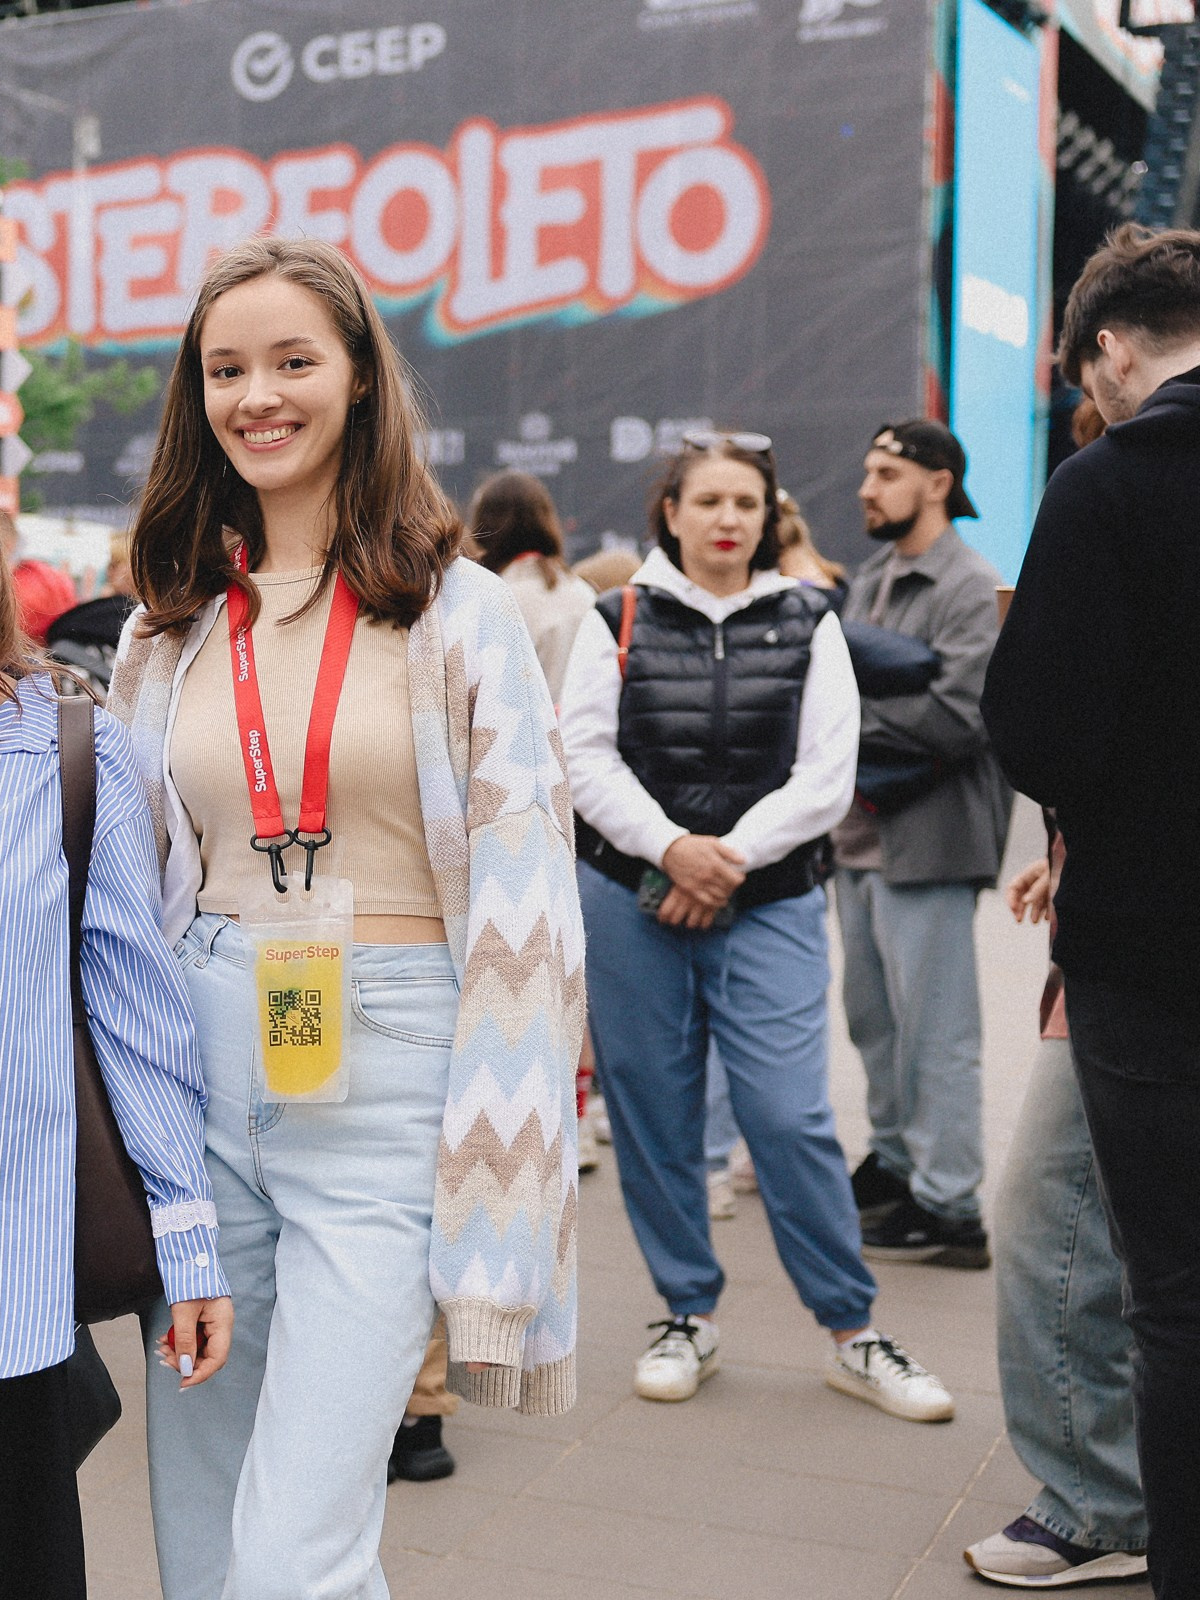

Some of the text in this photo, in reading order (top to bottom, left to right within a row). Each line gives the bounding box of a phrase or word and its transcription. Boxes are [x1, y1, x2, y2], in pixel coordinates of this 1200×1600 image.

[302, 21, 446, 83] СБЕР
[2, 101, 766, 339] STEREOLETO
[249, 729, 267, 793] SuperStep
[265, 945, 340, 964] SuperStep
